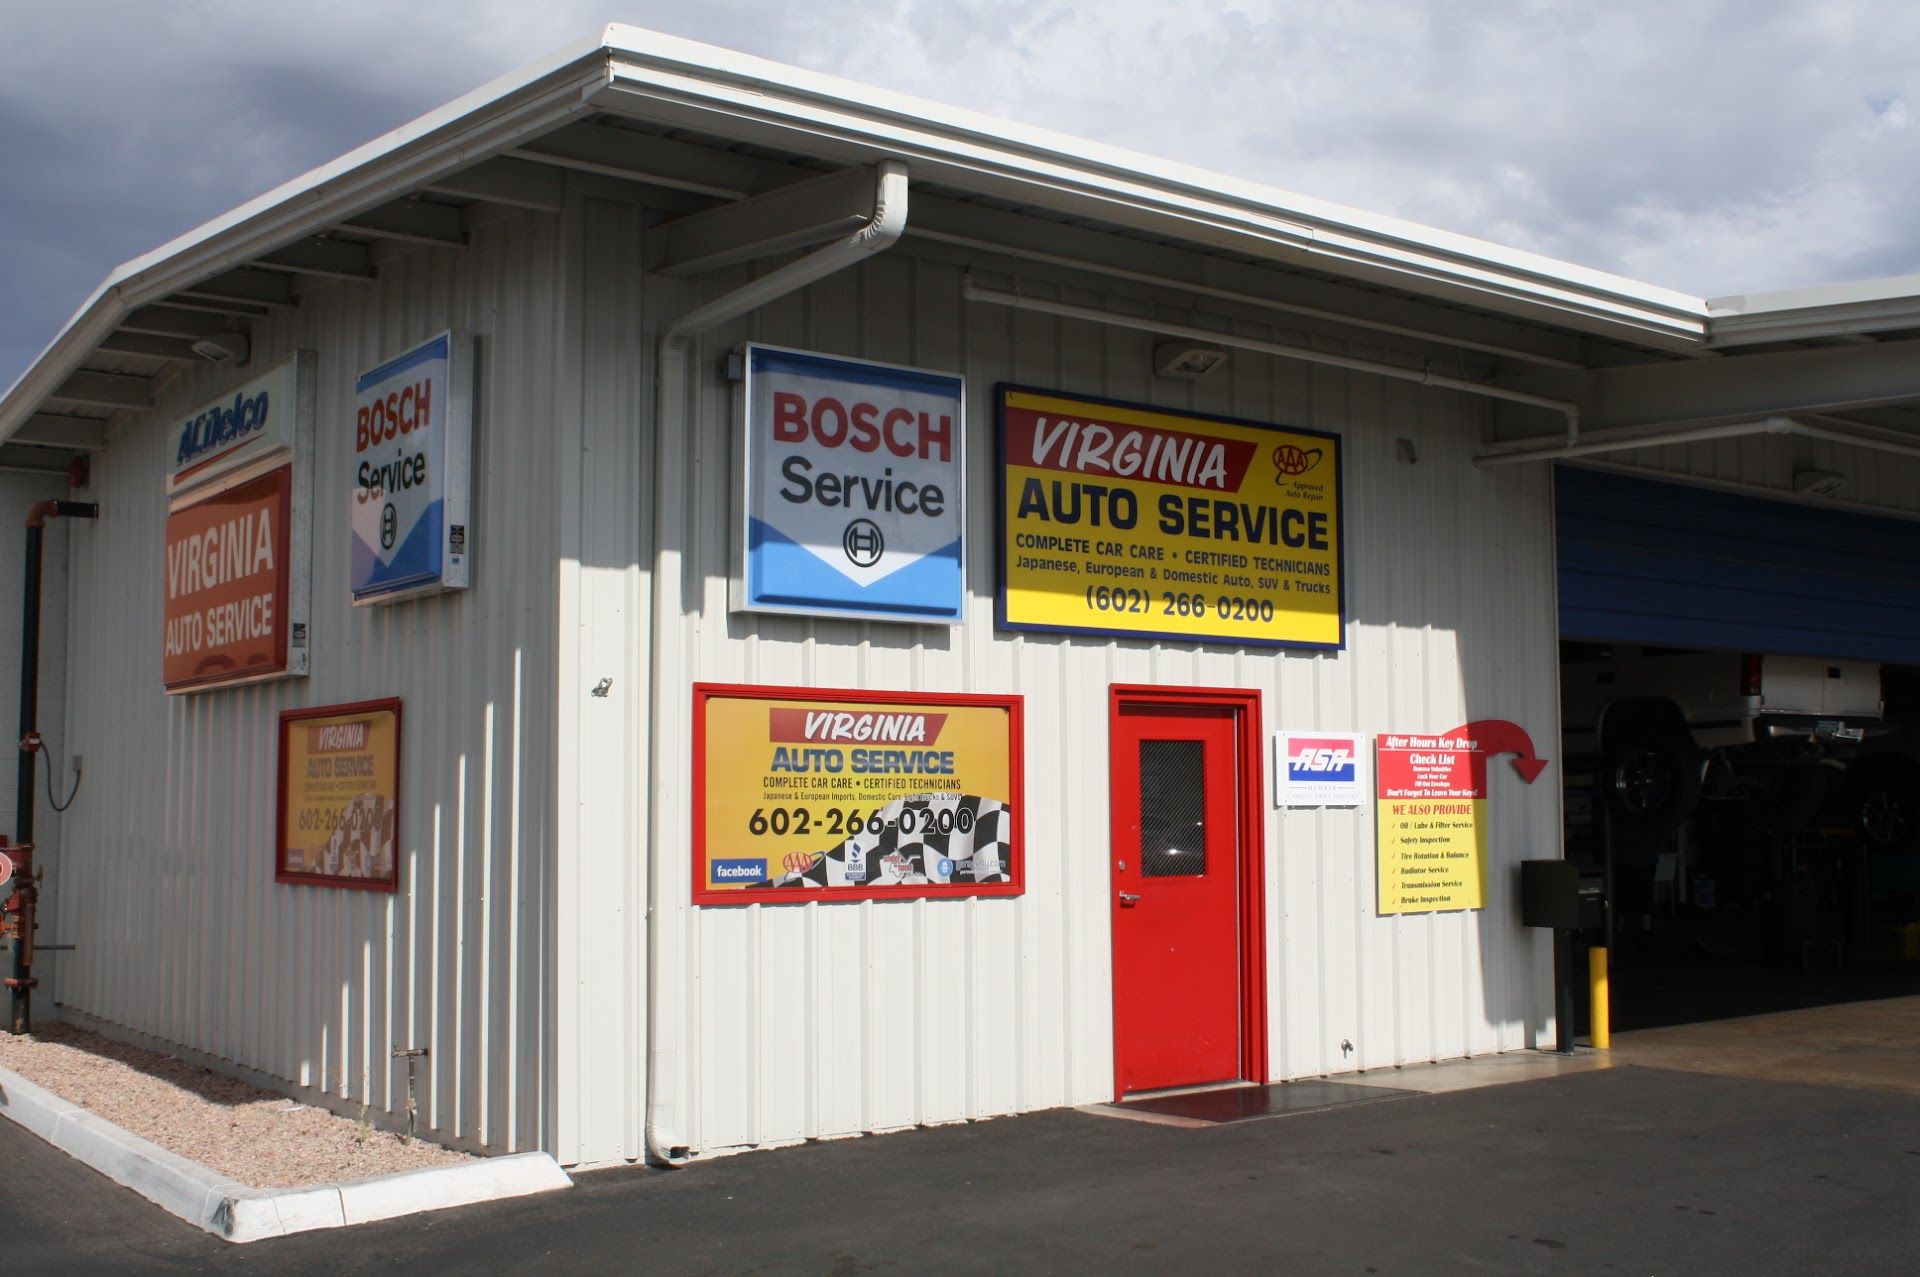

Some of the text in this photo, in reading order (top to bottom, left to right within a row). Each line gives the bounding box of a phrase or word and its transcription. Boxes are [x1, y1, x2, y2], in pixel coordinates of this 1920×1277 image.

[356, 378, 431, 452] BOSCH
[773, 391, 951, 462] BOSCH
[176, 391, 268, 467] ACDelco
[1032, 417, 1227, 488] VIRGINIA
[357, 448, 426, 504] Service
[779, 455, 945, 517] Service
[1293, 480, 1323, 492] Approved
[1303, 491, 1323, 501] Repair
[1017, 477, 1328, 550] AUTO SERVICE
[167, 508, 274, 599] VIRGINIA
[1016, 533, 1330, 576] COMPLETE CAR CARE CERTIFIED TECHNICIANS
[1016, 555, 1331, 594] Japanese, European & Domestic Auto, SUV & Trucks
[1086, 585, 1275, 623] (602) 266-0200
[165, 611, 203, 657] AUTO
[206, 593, 272, 648] SERVICE
[319, 723, 364, 750] VIRGINIA
[805, 712, 926, 742] VIRGINIA
[1386, 736, 1478, 750] After Hours Key Drop
[307, 754, 375, 778] AUTO SERVICE
[771, 747, 954, 774] AUTO SERVICE
[1292, 748, 1350, 772] ASA
[1409, 753, 1455, 765] Check List
[763, 777, 961, 790] COMPLETE CAR CARE CERTIFIED TECHNICIANS
[1404, 789, 1423, 797] Forget
[763, 792, 792, 801] Japanese
[794, 792, 799, 800] &
[800, 792, 830, 801] European
[858, 793, 886, 801] Domestic
[940, 793, 945, 801] &
[749, 807, 976, 835] 602-266-0200
[1392, 804, 1473, 815] WE ALSO PROVIDE
[1400, 836, 1450, 845] Safety Inspection
[717, 865, 762, 877] facebook
[848, 863, 863, 871] BBB
[1401, 867, 1426, 875] Radiator
[1402, 881, 1441, 889] Transmission
[1420, 895, 1451, 903] Inspection
